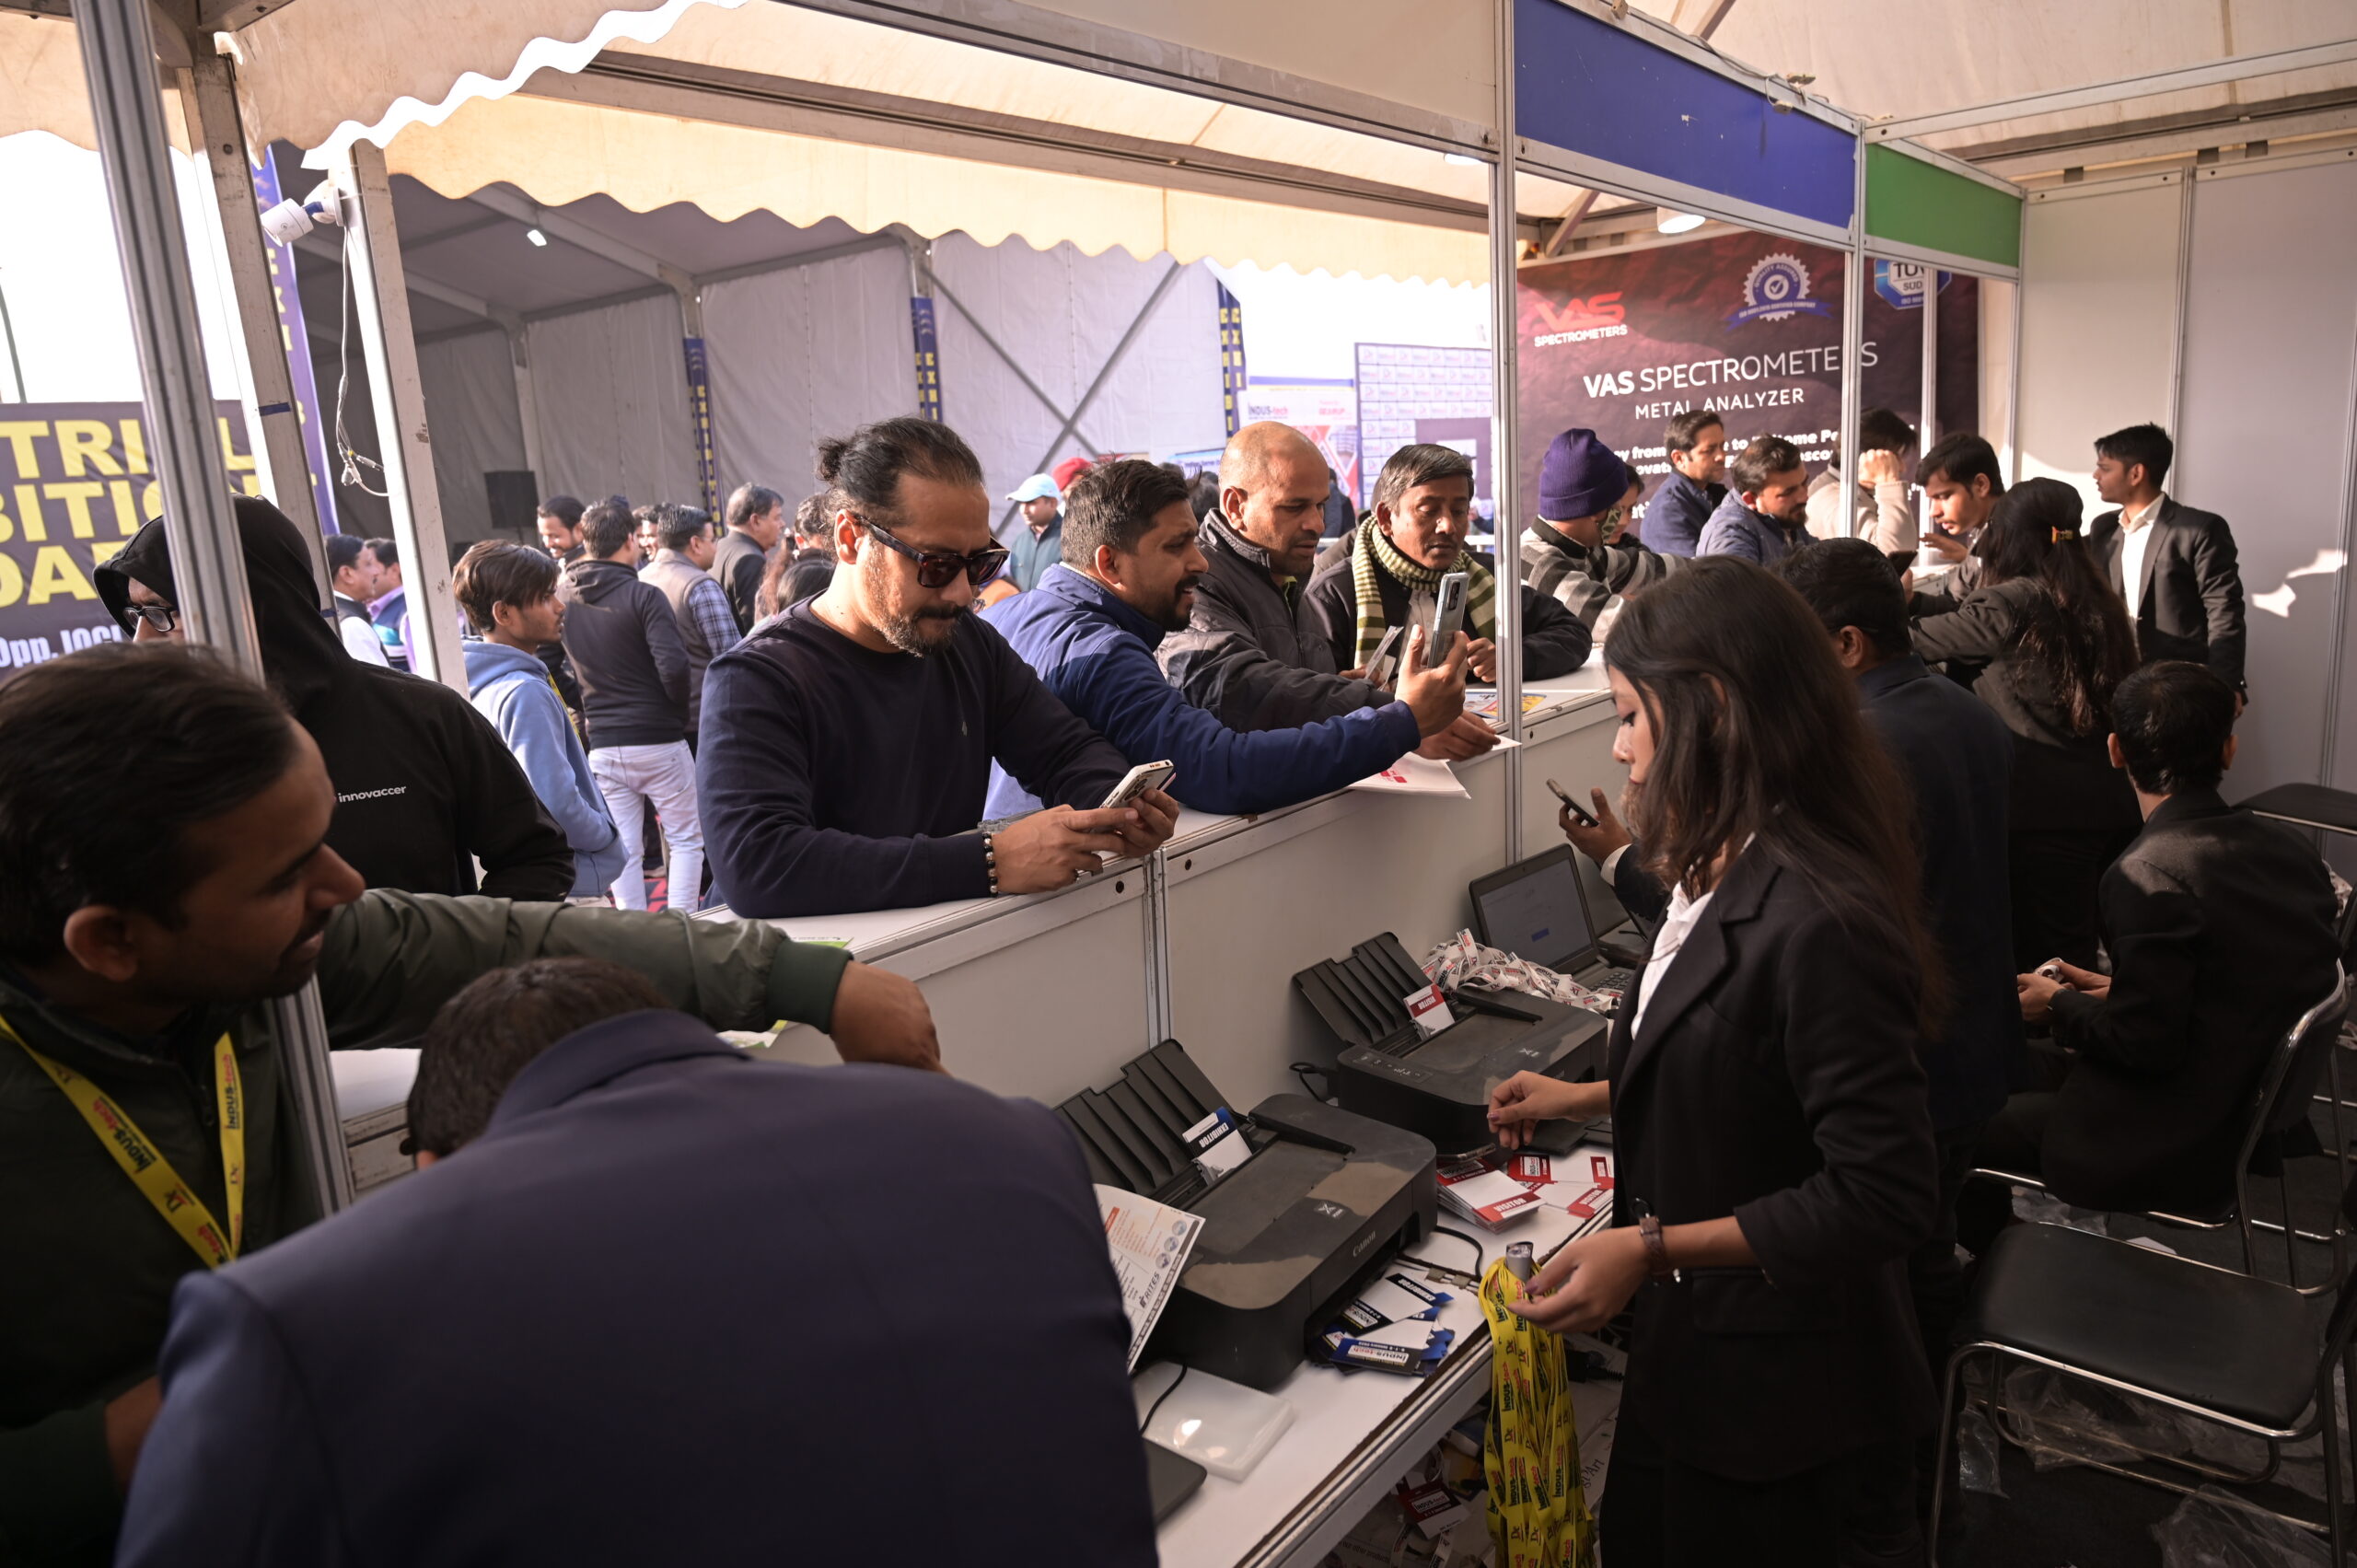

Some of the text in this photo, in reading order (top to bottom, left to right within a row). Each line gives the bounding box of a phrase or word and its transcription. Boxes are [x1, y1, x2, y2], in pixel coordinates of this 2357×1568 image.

[1536, 292, 1625, 332] VAS
[1534, 324, 1628, 347] SPECTROMETERS
[1583, 342, 1878, 398] VAS SPECTROMETES
[1702, 388, 1805, 412] ANALYZER
[1631, 446, 1666, 459] from
[1732, 438, 1748, 451] to
[338, 785, 407, 803] innovaccer
[1418, 995, 1436, 1011] VISITOR
[1199, 1121, 1229, 1148] EXHIBITOR
[1493, 1198, 1527, 1213] VISITOR
[1353, 1231, 1376, 1258] Canon
[1145, 1272, 1160, 1299] RITES
